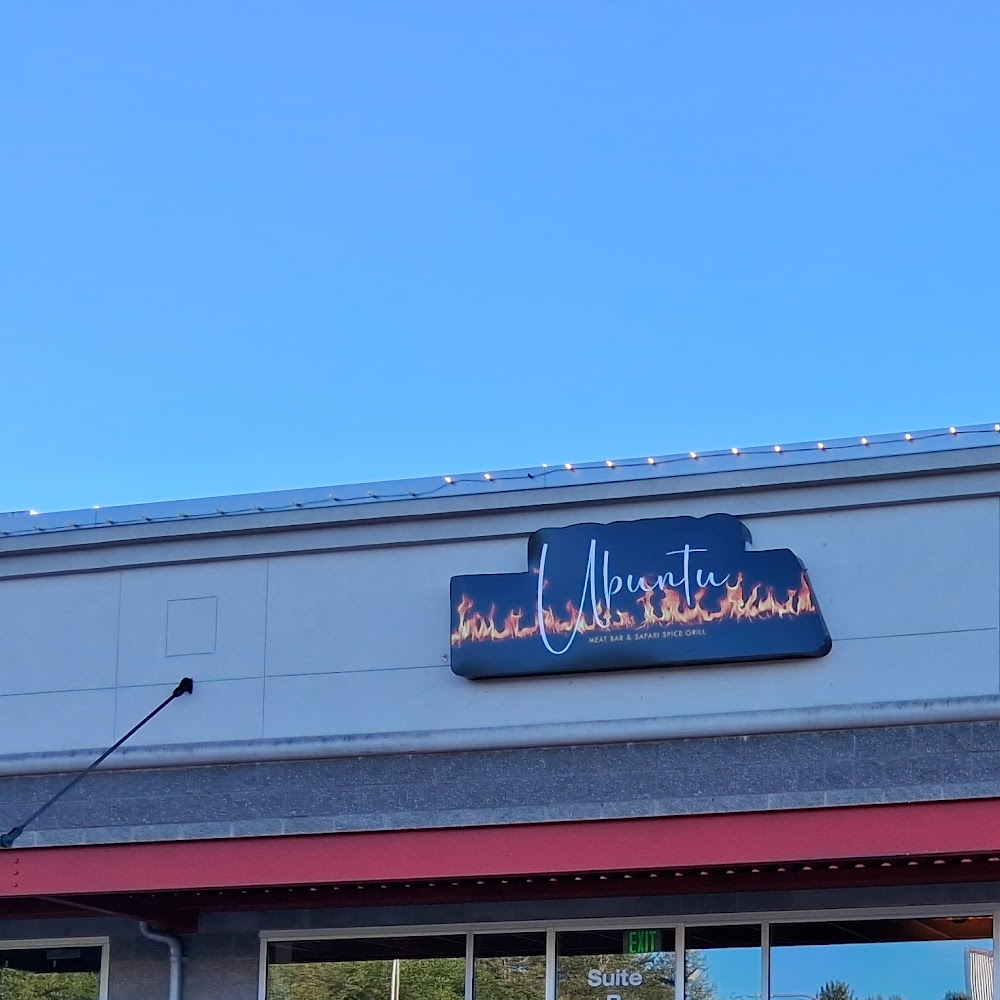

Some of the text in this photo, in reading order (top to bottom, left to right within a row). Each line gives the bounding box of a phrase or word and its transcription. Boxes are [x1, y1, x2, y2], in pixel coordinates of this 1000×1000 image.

[537, 539, 731, 654] Ubuntu
[588, 635, 607, 644] MEAT
[609, 634, 625, 642] BAR
[634, 631, 660, 640] SAFARI
[662, 629, 683, 638] SPICE
[685, 627, 706, 637] GRILL
[628, 930, 657, 954] EXIT
[587, 968, 643, 987] Suite
